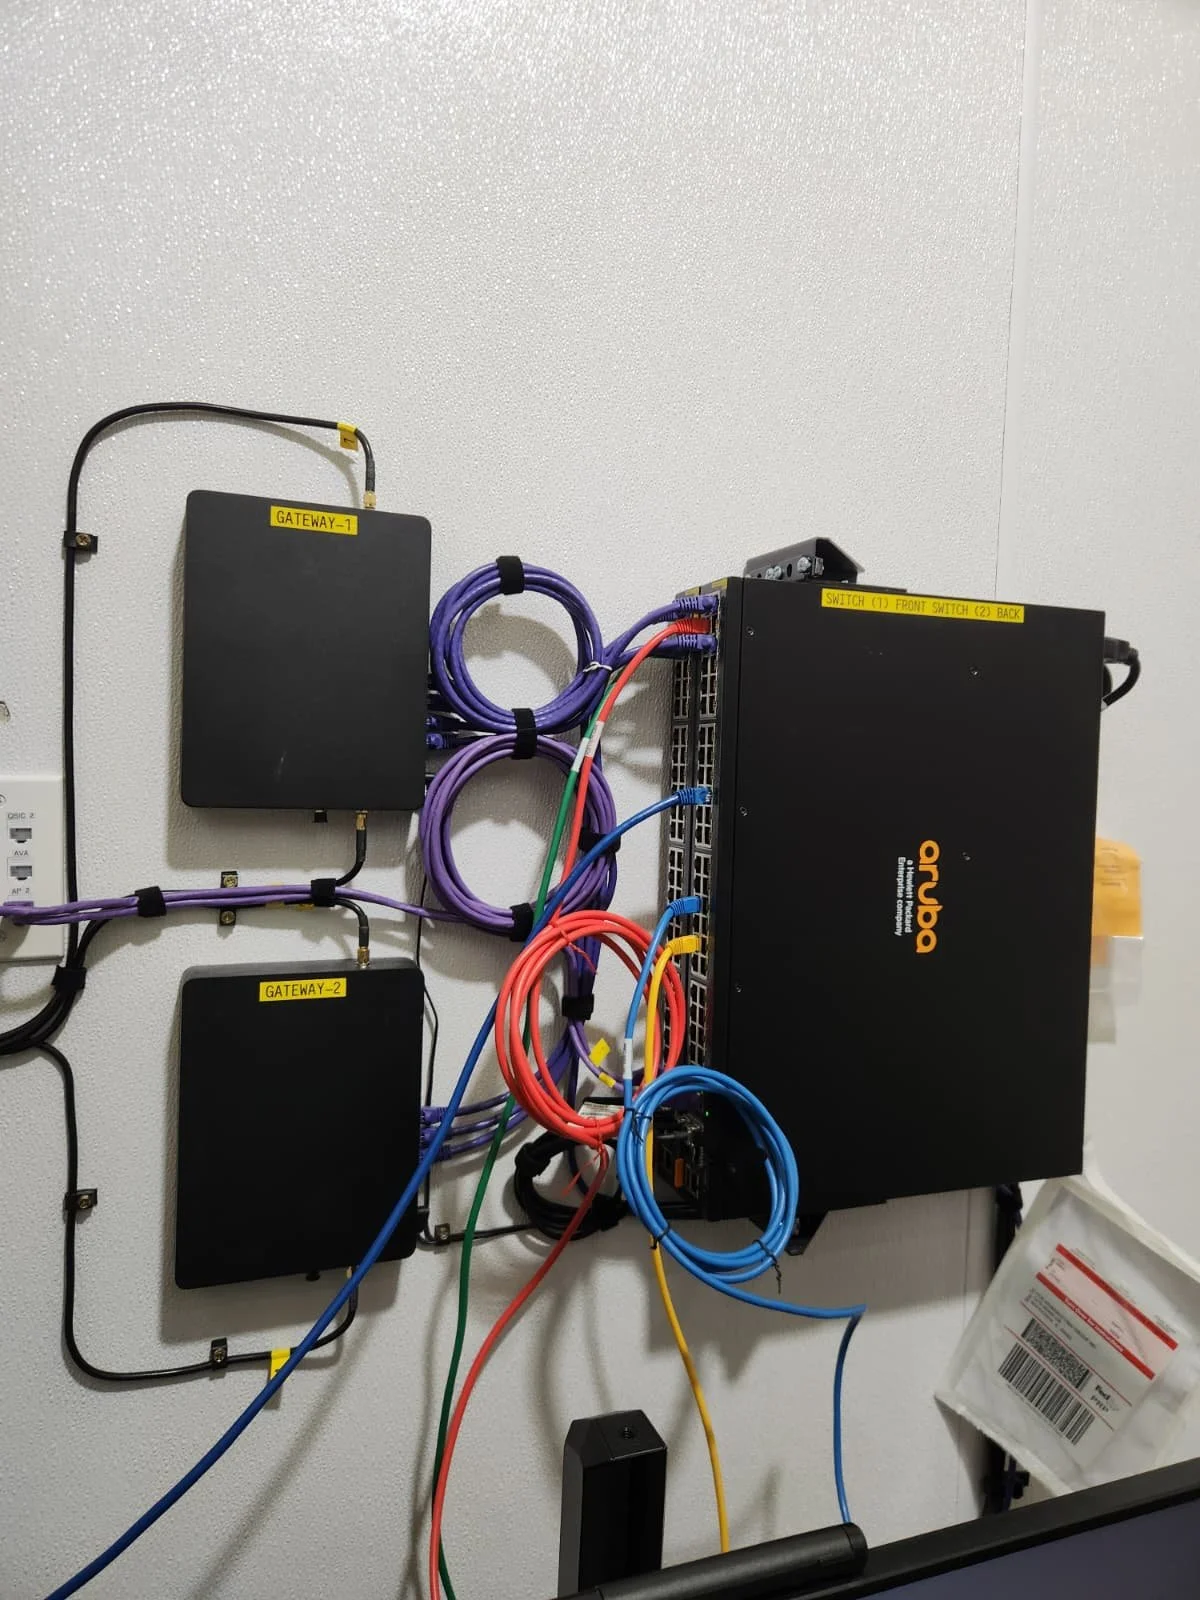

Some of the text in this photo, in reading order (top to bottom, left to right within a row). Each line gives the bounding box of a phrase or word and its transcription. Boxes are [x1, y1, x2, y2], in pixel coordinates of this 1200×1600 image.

[276, 510, 351, 532] GATEWAY-1
[826, 592, 1021, 620] SWITCH (1) FRONT SWITCH (2) BACK
[894, 856, 906, 936] Enterprise company
[905, 866, 915, 899] Hewlett
[916, 839, 943, 954] aruba
[904, 900, 914, 933] Packard
[265, 981, 342, 998] GATEWAY-2
